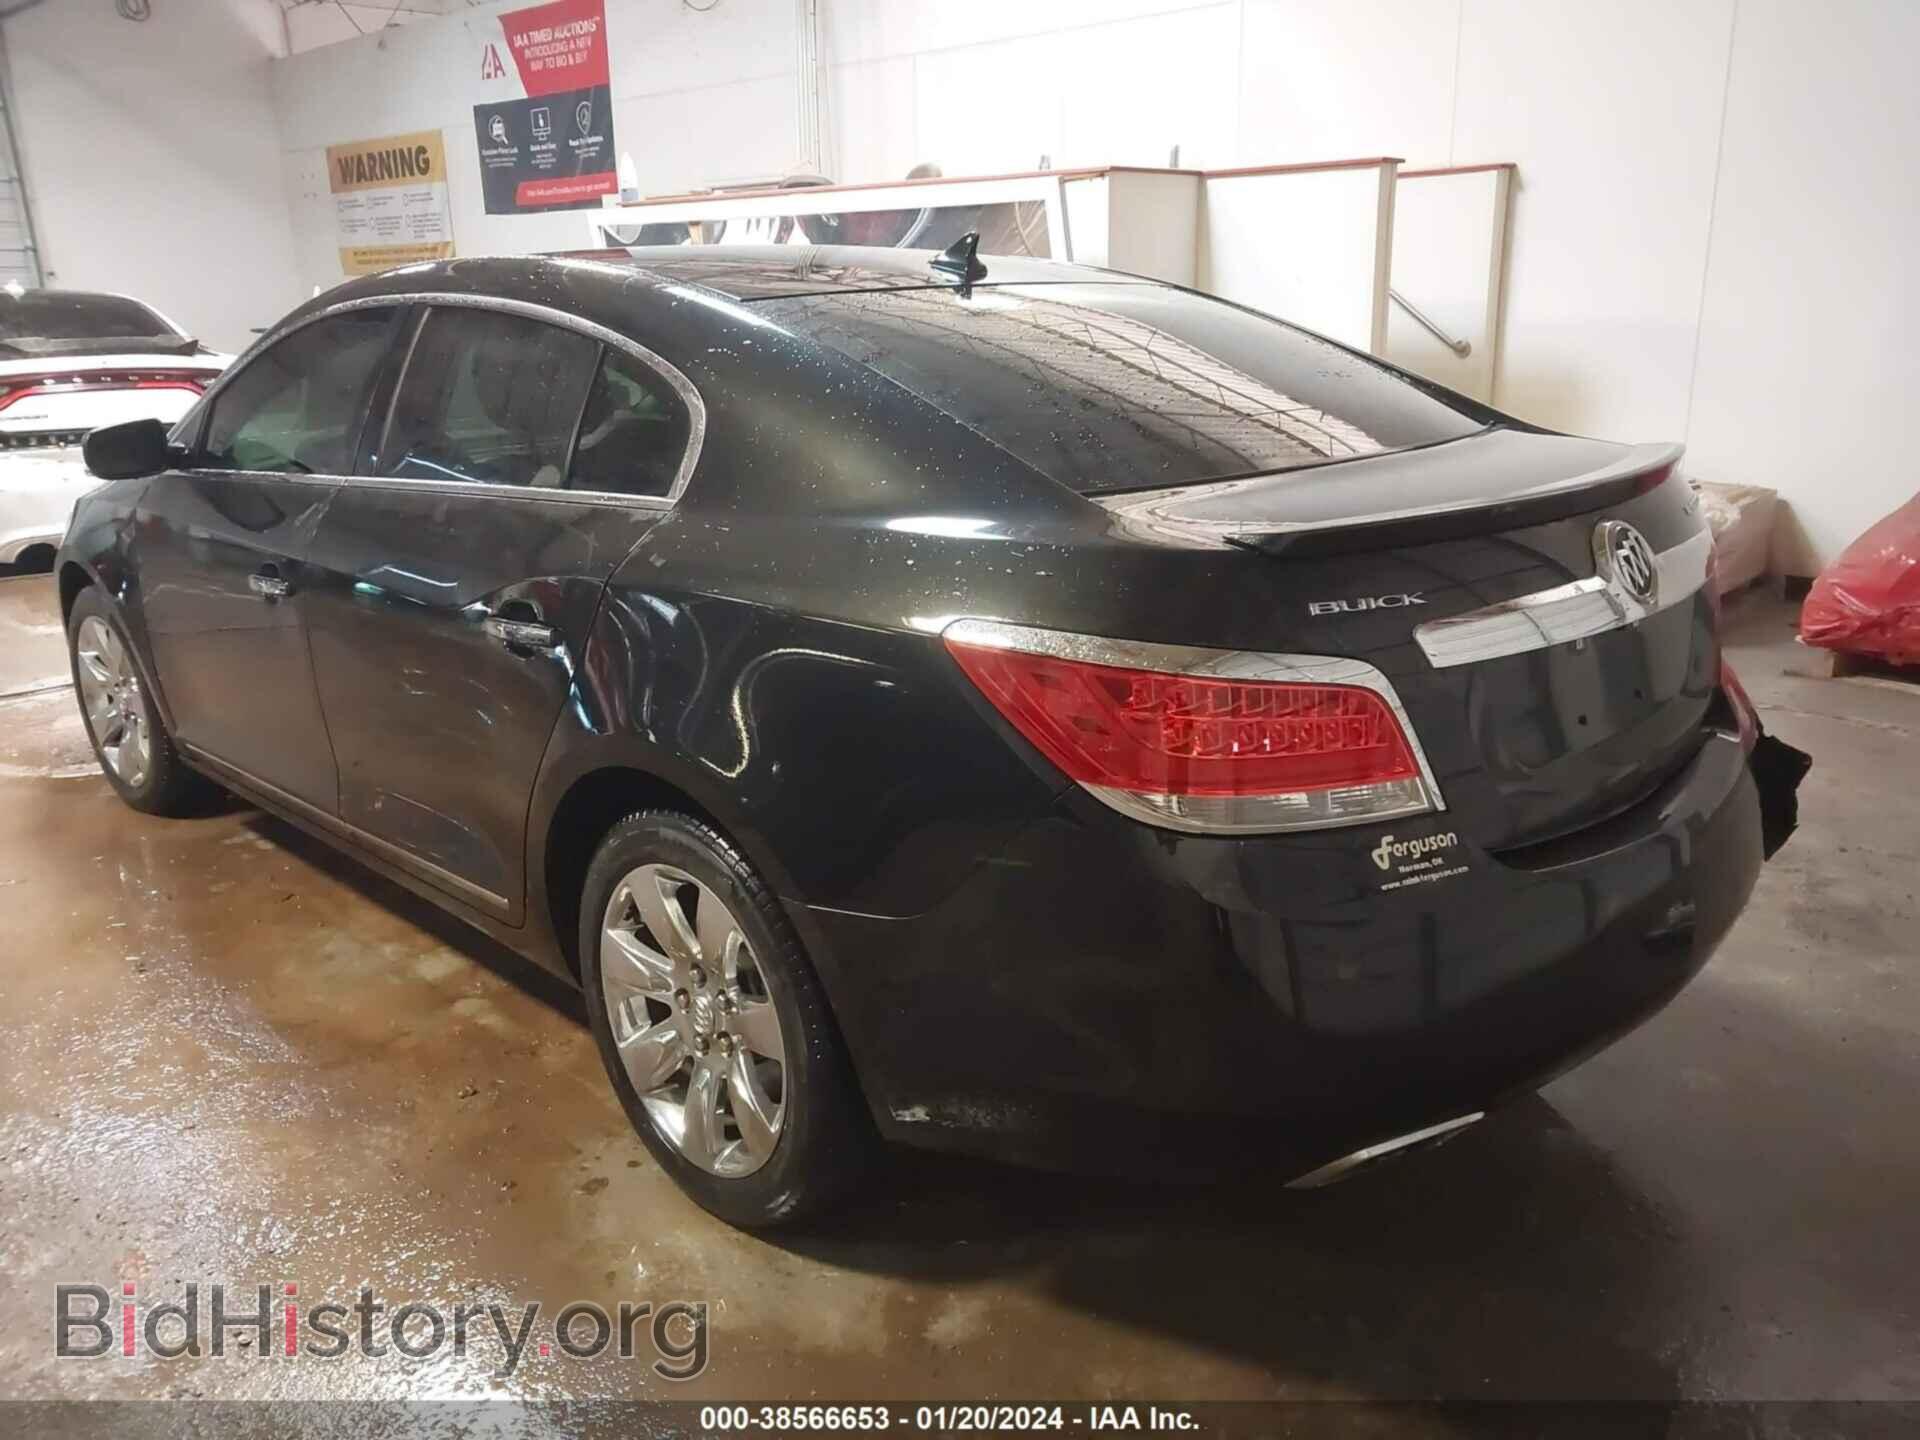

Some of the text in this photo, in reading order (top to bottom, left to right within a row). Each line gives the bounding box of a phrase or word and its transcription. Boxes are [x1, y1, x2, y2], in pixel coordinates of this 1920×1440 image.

[529, 28, 553, 44] TIMED
[545, 56, 555, 69] TO
[337, 145, 431, 185] WARNING
[1308, 591, 1429, 616] BUICK
[1371, 832, 1458, 870] Ferguson
